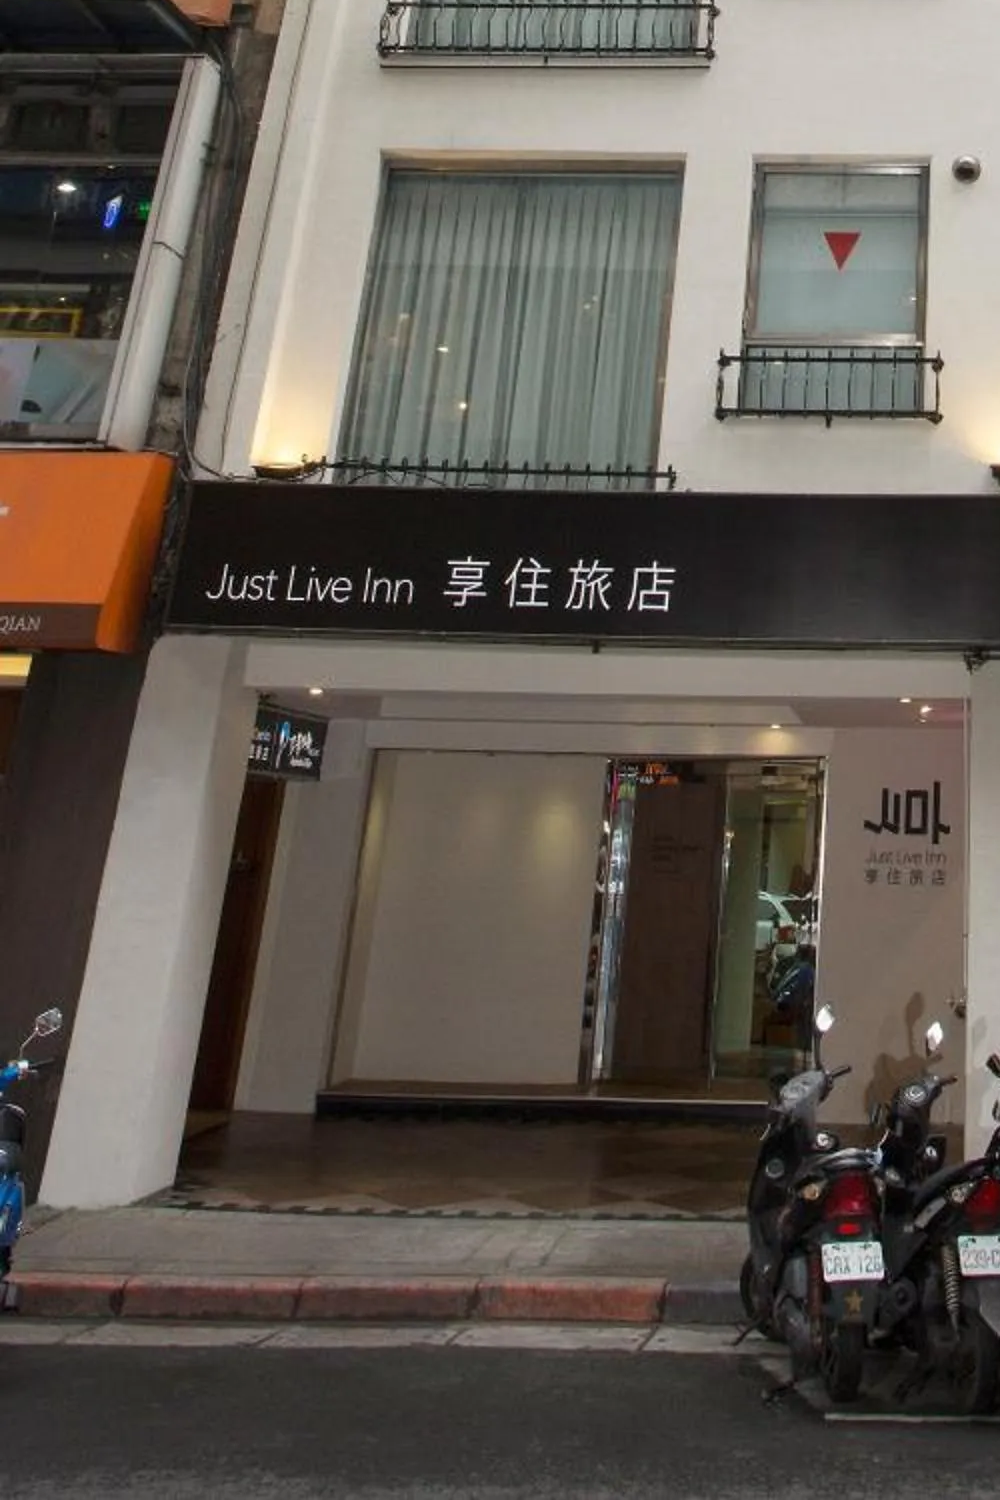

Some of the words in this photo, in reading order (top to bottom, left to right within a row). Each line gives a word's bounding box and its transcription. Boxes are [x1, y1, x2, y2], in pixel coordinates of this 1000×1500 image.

[205, 563, 278, 602] Just
[286, 564, 354, 604] Live
[362, 566, 415, 605] Inn
[443, 556, 677, 613] 享住旅店
